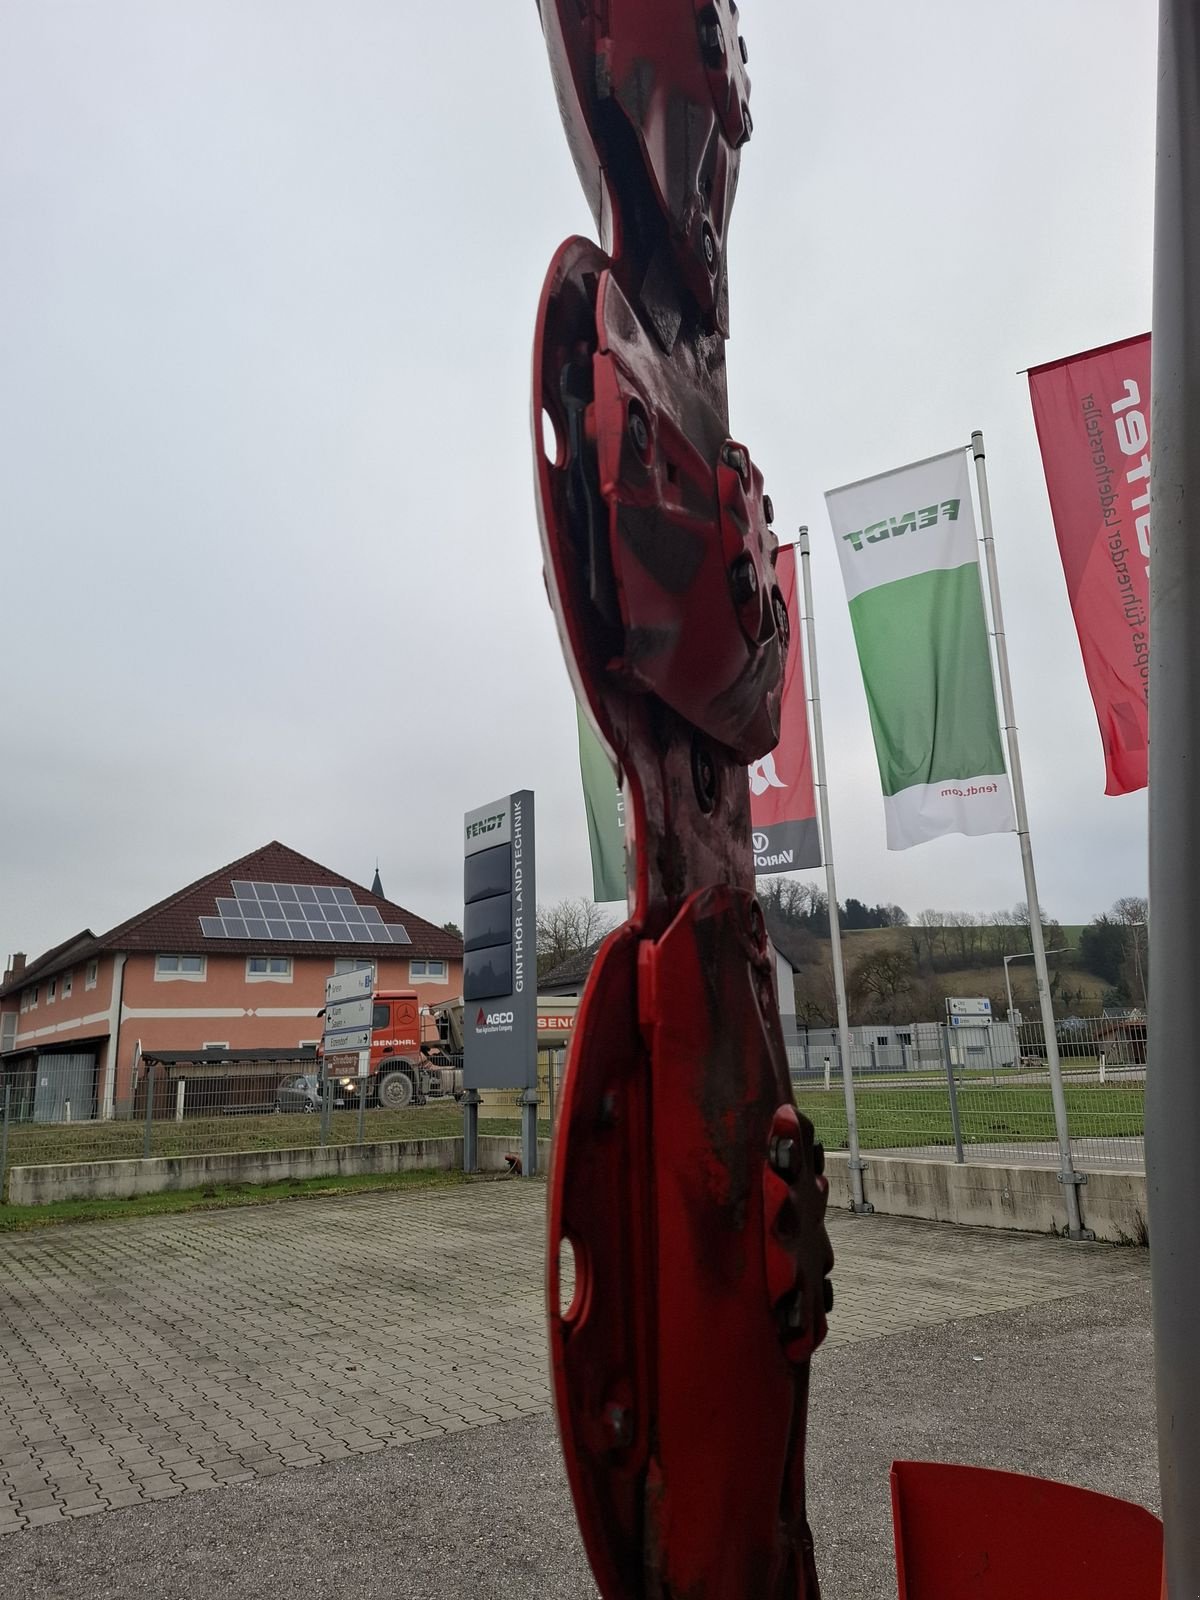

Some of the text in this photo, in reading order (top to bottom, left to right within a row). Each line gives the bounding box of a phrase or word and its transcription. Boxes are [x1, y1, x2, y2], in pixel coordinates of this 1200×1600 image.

[466, 812, 506, 840] FENDT
[514, 800, 524, 993] GINTHÖR LANDTECHNIK
[486, 1011, 514, 1025] AGCO
[370, 1038, 417, 1047] SENÖHRL
